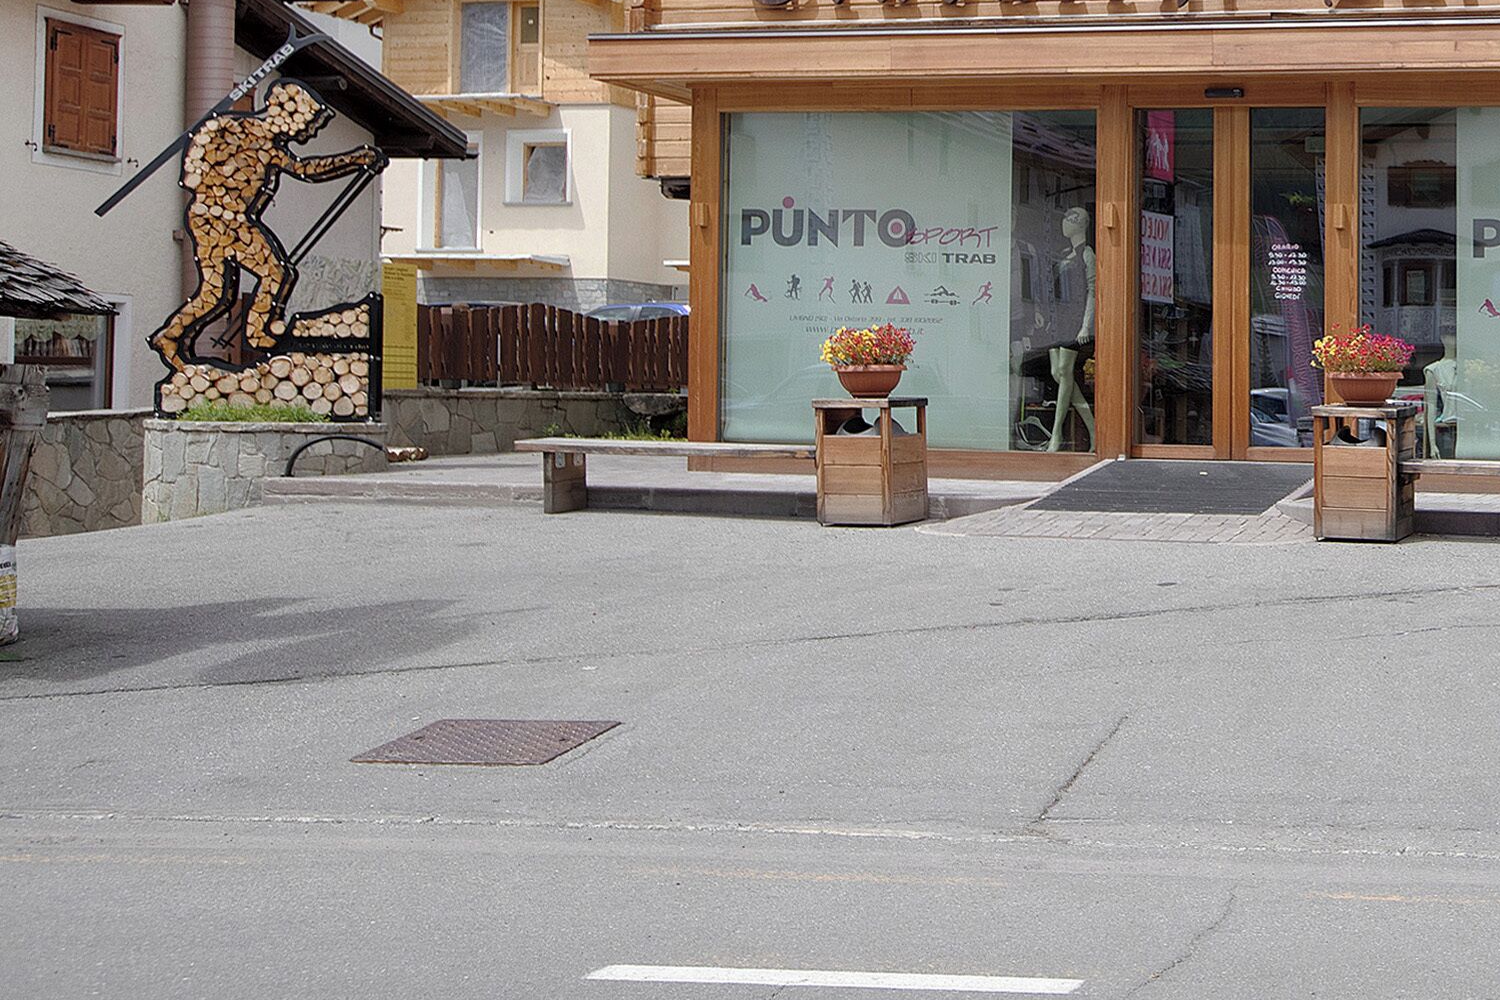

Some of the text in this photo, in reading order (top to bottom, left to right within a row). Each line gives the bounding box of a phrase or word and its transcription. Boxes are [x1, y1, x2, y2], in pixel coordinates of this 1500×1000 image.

[741, 196, 916, 248] PUNTO
[904, 226, 998, 249] SPORT
[904, 252, 997, 265] SKI TRAB
